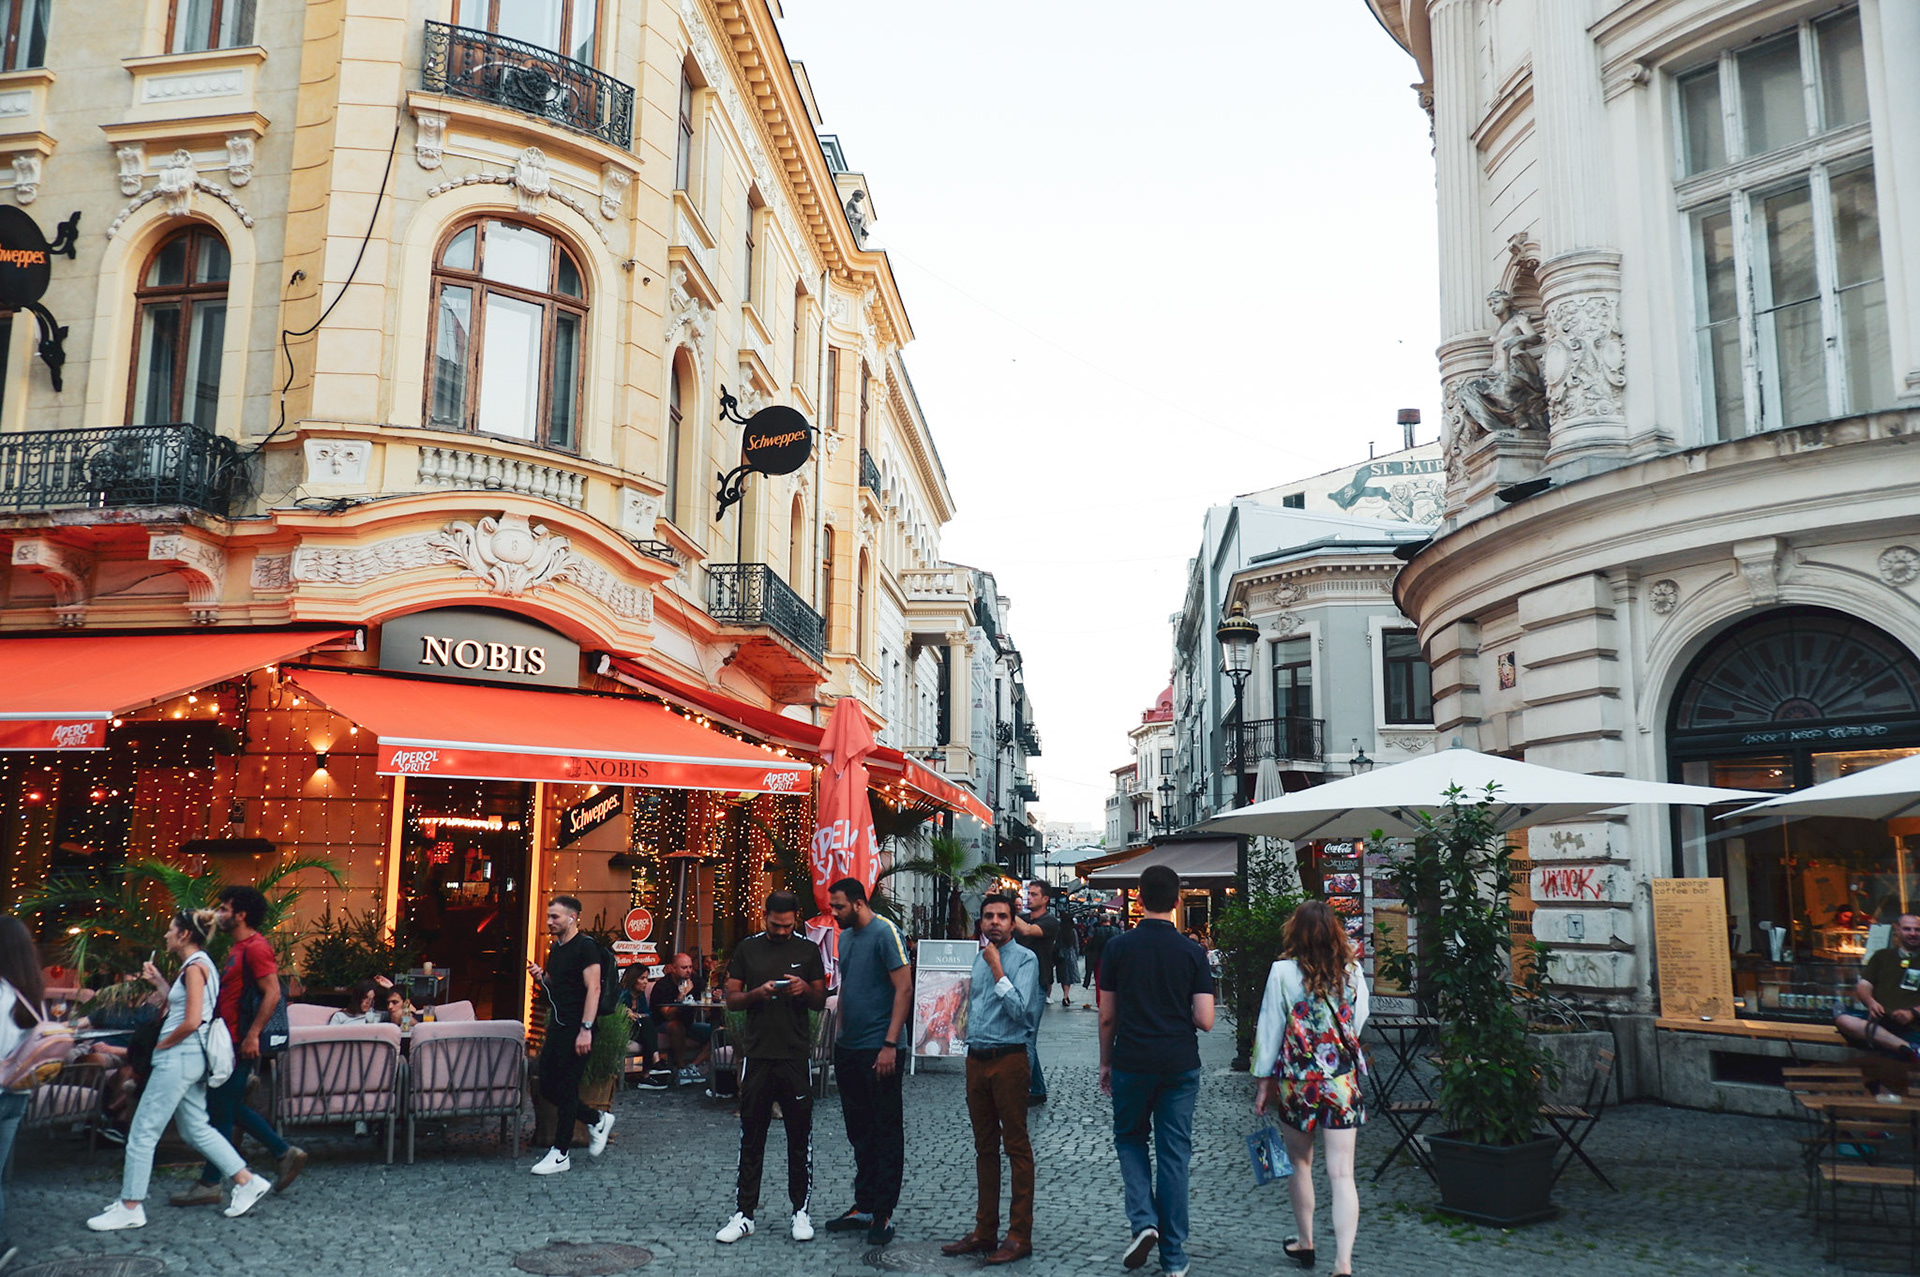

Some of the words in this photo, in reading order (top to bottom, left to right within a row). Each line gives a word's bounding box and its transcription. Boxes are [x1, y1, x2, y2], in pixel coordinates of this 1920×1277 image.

[1370, 463, 1393, 476] ST.
[1402, 460, 1445, 474] PATR
[420, 635, 547, 675] NOBIS
[51, 723, 96, 741] APEROL
[57, 735, 87, 748] SPRITZ
[390, 750, 439, 766] APEROL
[398, 762, 431, 773] SPRITZ
[584, 760, 649, 778] NOBIS
[762, 772, 800, 786] APEROL
[769, 781, 794, 792] SPRITZ
[1654, 887, 1688, 895] coffee
[1692, 887, 1710, 895] bar
[1675, 880, 1709, 888] george
